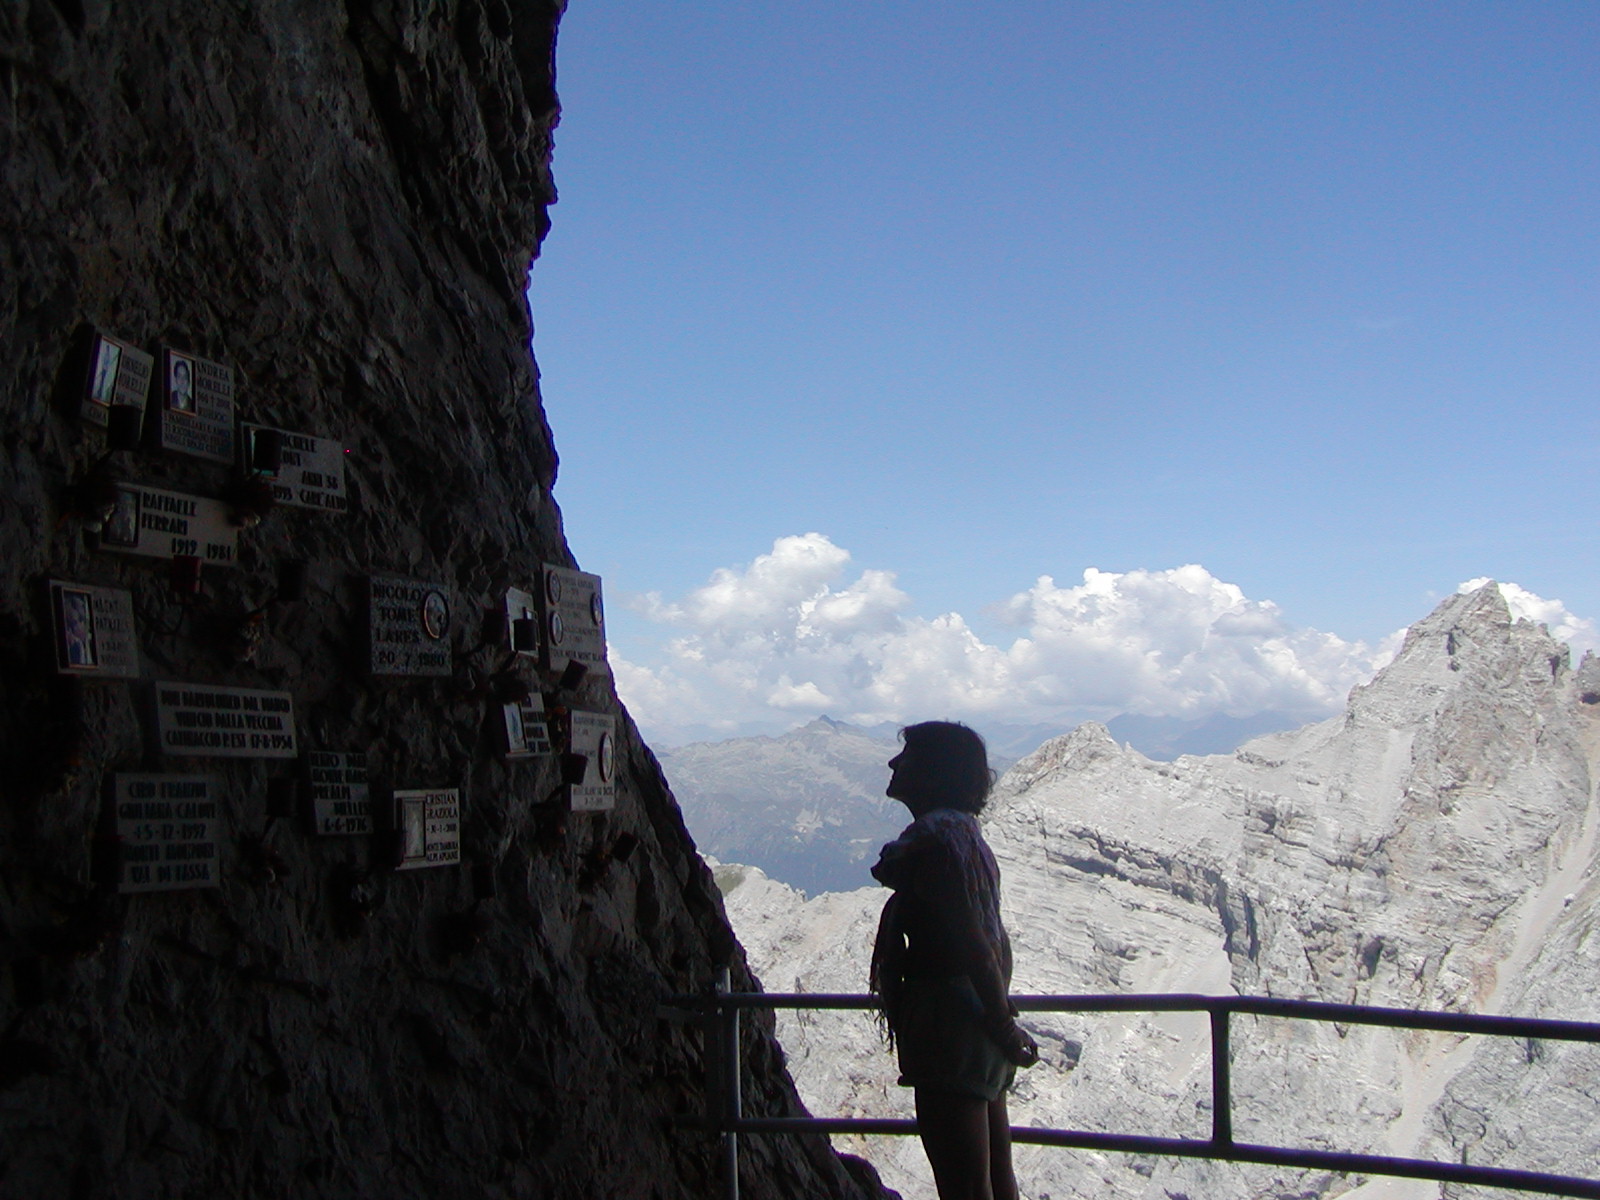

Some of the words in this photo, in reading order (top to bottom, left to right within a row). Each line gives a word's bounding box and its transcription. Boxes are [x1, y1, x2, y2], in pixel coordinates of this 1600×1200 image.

[197, 361, 230, 381] ANDREA
[142, 492, 196, 517] RAFFAELE
[141, 512, 188, 536] FERRARI
[171, 537, 198, 556] 1919
[207, 543, 231, 561] 1981
[426, 793, 456, 806] CRISTIAN
